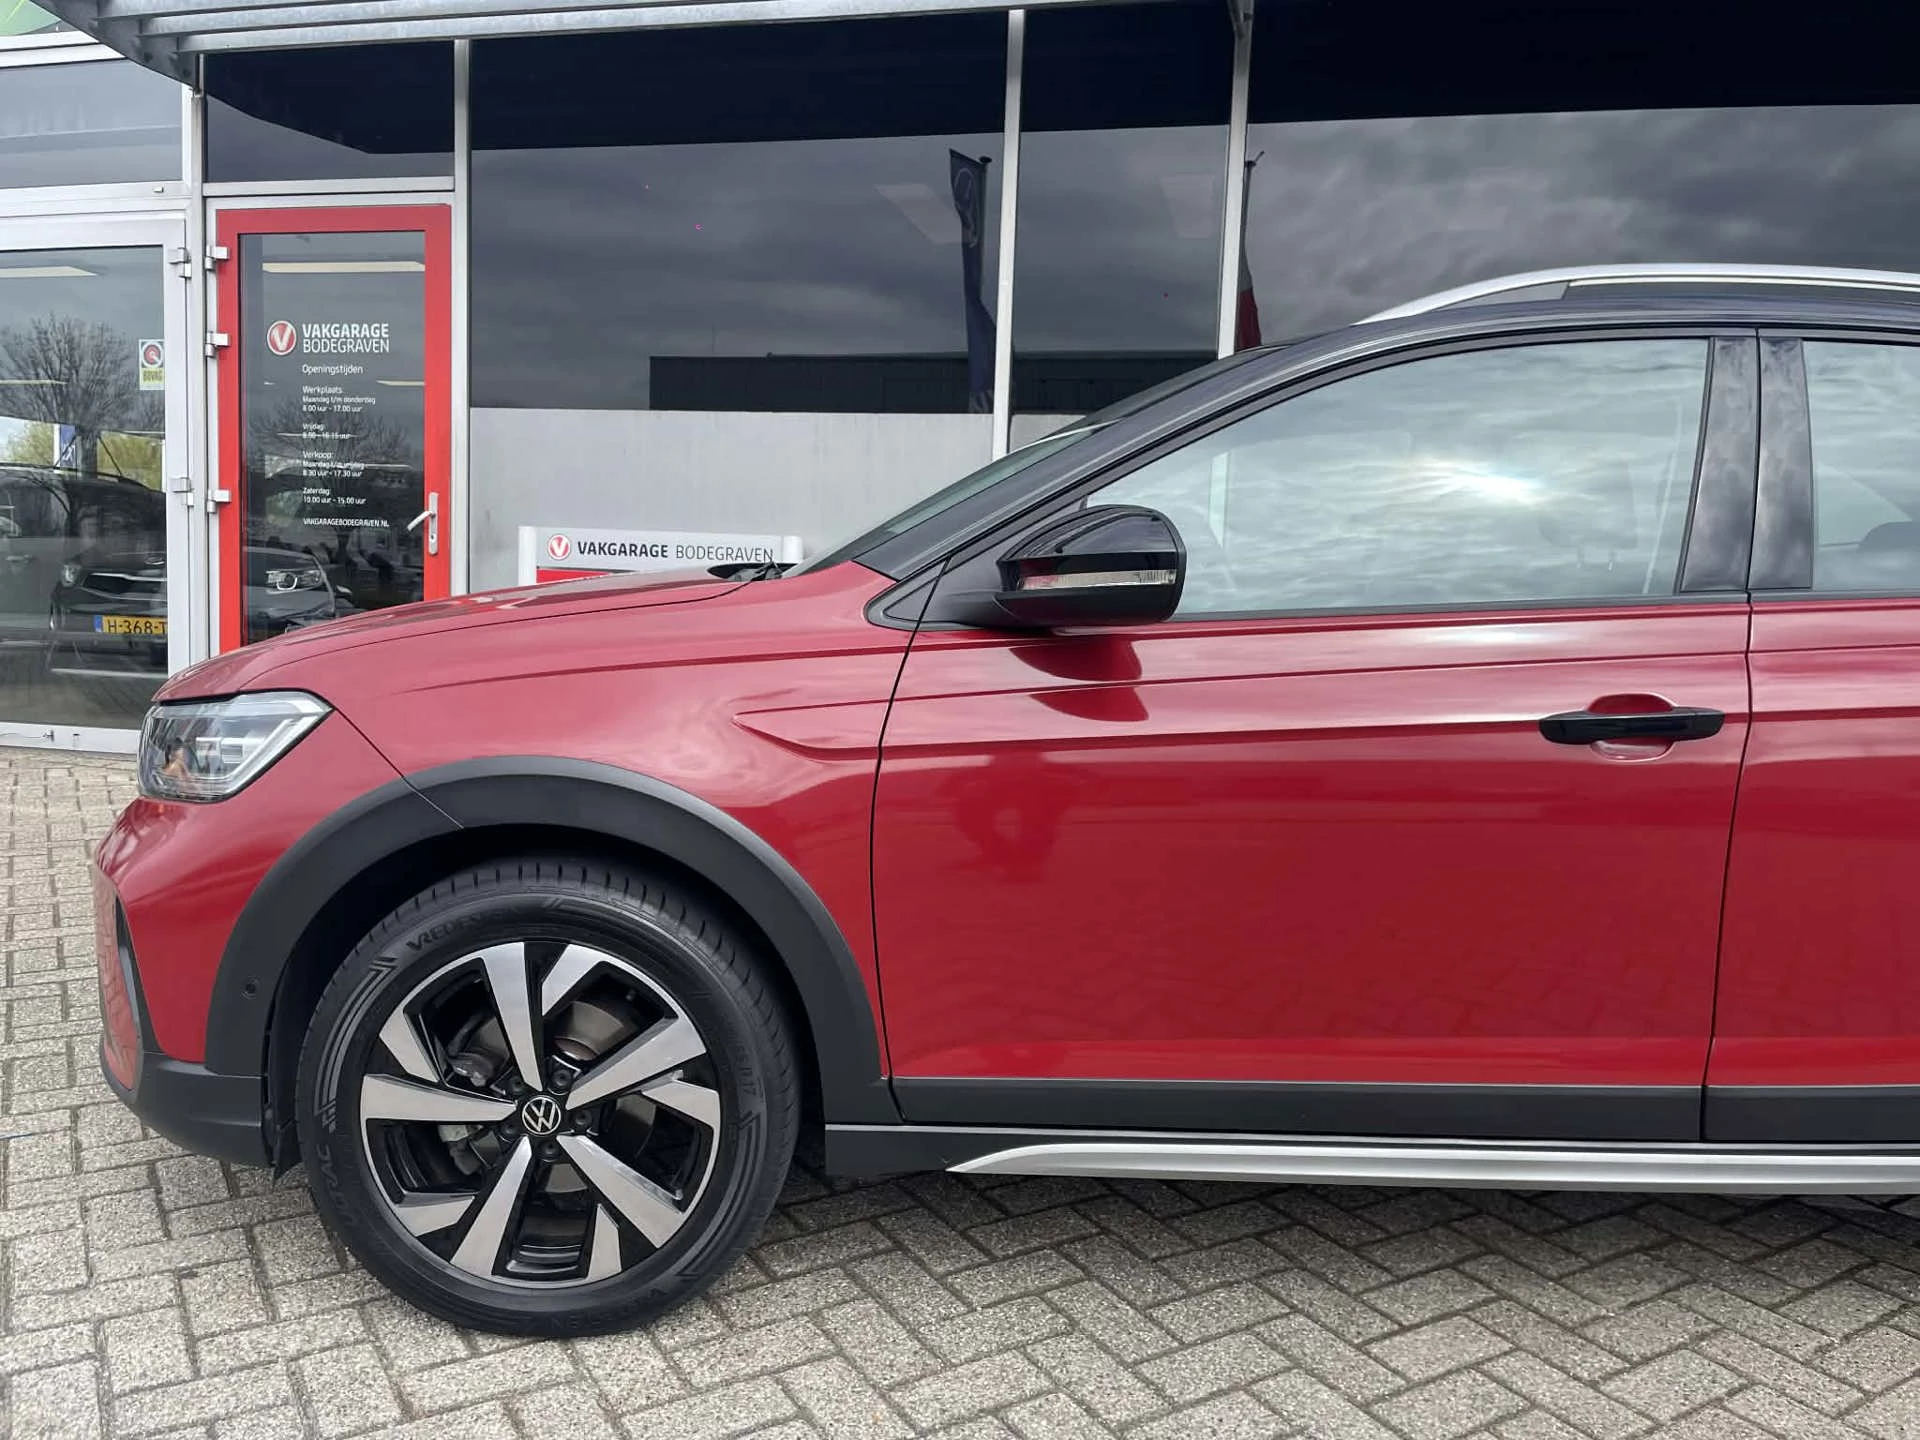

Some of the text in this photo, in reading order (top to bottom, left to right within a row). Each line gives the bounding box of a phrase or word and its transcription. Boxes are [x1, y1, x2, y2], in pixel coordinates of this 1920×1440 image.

[302, 323, 389, 338] VAKGARAGE
[303, 338, 390, 353] BODEGRAVEN
[302, 363, 363, 376] Openingstijden
[577, 541, 669, 558] VAKGARAGE
[675, 544, 774, 563] BODEGRAVEN
